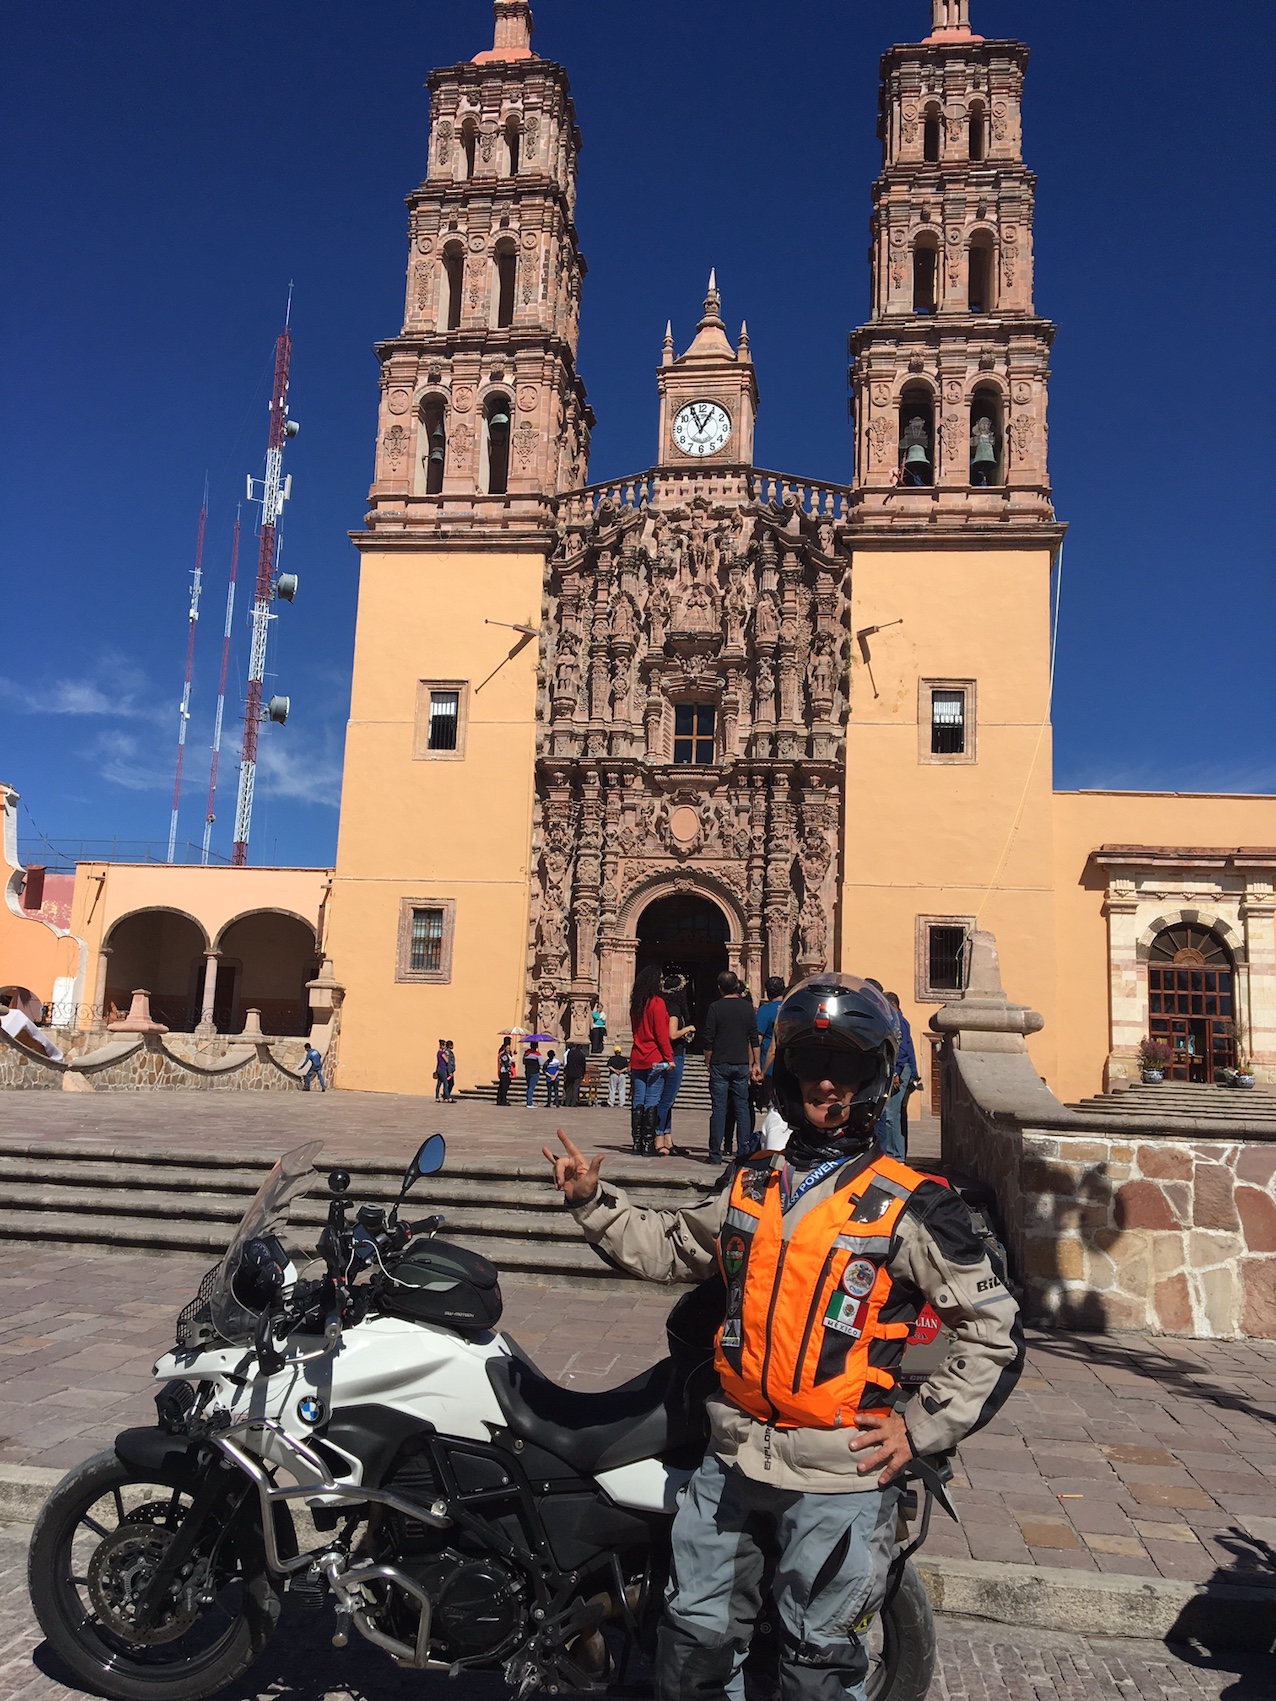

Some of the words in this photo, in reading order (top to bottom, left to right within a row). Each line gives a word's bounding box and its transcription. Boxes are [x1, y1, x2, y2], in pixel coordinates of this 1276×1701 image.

[699, 404, 707, 412] 12
[681, 415, 688, 423] 10
[719, 414, 724, 422] 2
[677, 425, 682, 433] 9
[722, 424, 728, 432] 3
[688, 443, 693, 452] 7
[699, 445, 704, 453] 6
[710, 442, 715, 450] 5
